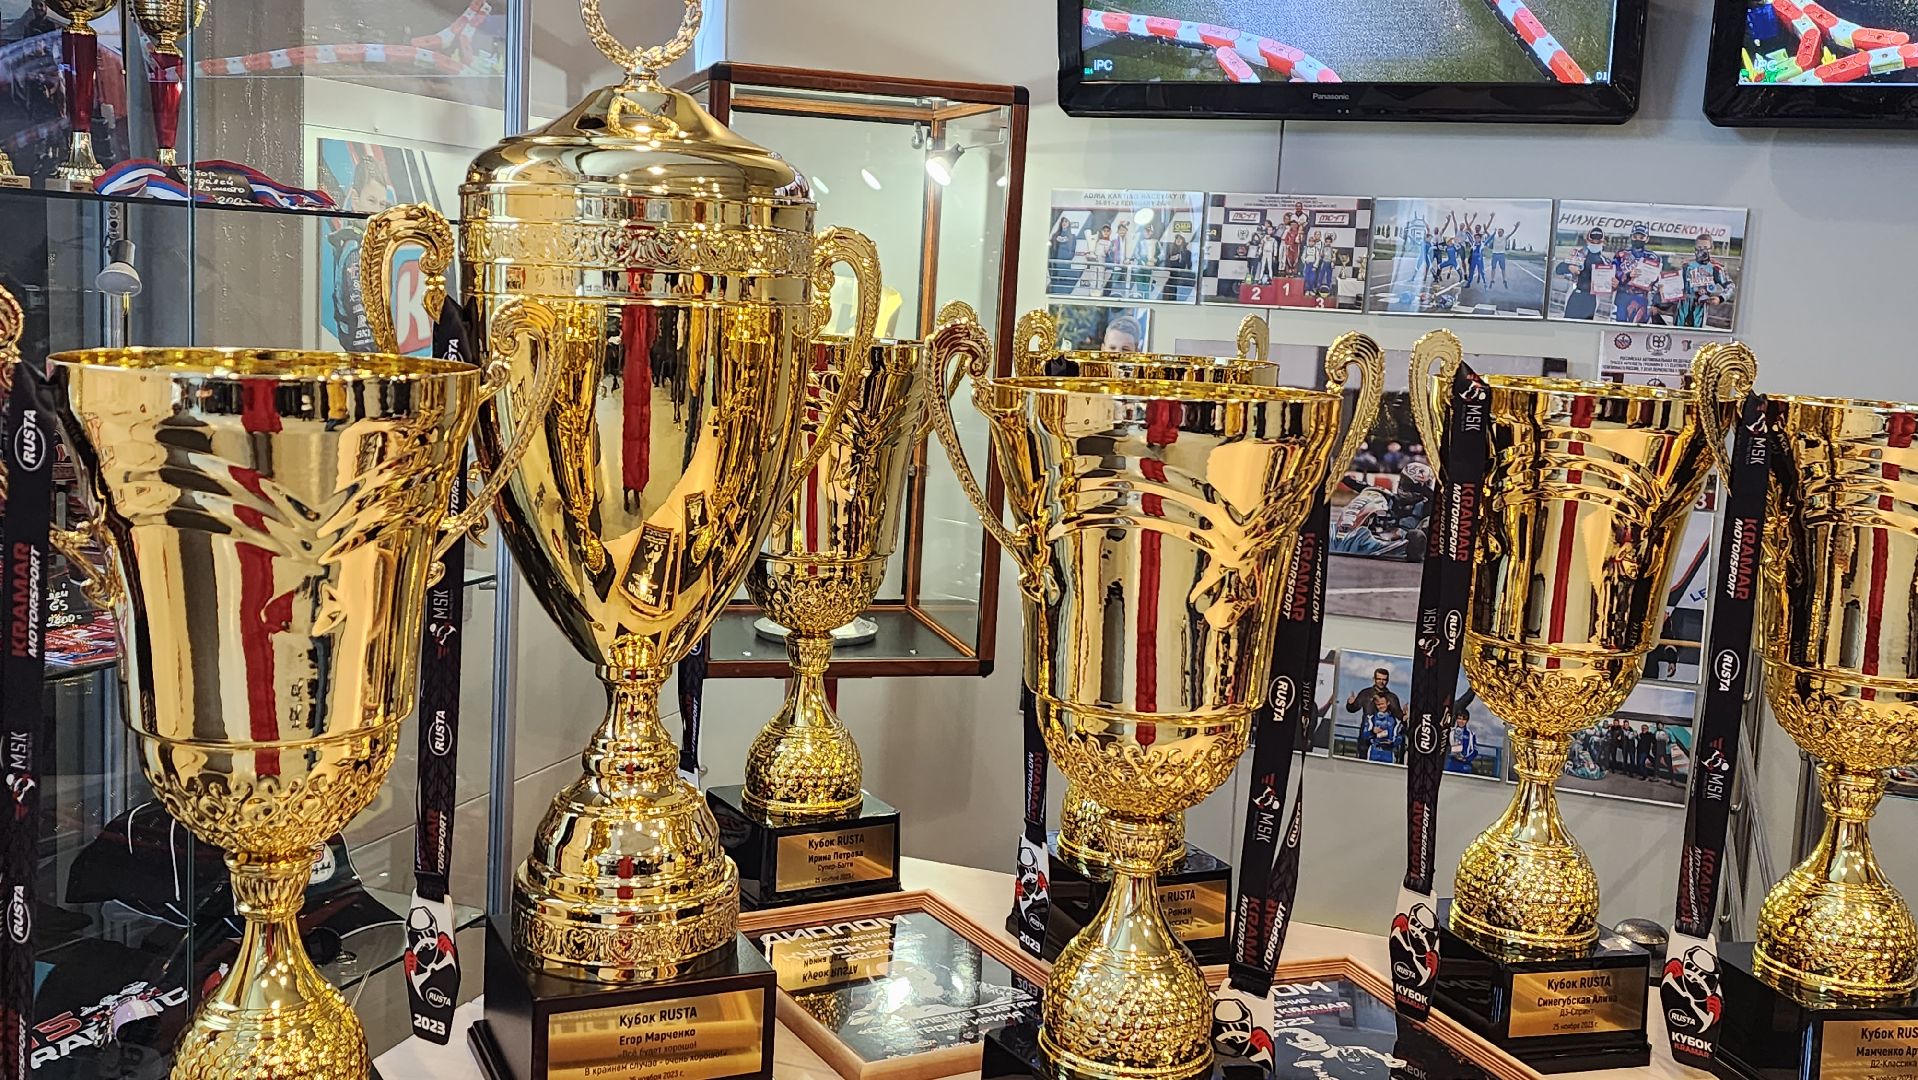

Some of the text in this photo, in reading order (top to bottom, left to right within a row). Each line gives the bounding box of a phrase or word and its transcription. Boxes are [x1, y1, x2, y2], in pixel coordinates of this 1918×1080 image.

[1093, 59, 1113, 71] IPC
[1312, 92, 1350, 100] Panasonic
[1251, 286, 1261, 300] 2
[1282, 283, 1290, 296] 1
[1315, 297, 1325, 309] 3
[1464, 403, 1482, 432] MSK
[23, 409, 37, 464] RUSTA
[1750, 437, 1767, 465] MSK
[1448, 482, 1462, 561] MOTORSPORT
[1457, 482, 1476, 562] KRAMAR
[1726, 517, 1744, 600] MOTORSPORT
[1734, 518, 1758, 601] KRAMAR
[1291, 531, 1317, 623] KRAMAR
[11, 542, 31, 657] KRAMAR
[27, 544, 42, 659] MOTORSPORT
[432, 588, 449, 620] MSK
[1422, 607, 1437, 634] MSK
[1448, 614, 1458, 651] RUSTA
[1718, 653, 1734, 693] RUSTA
[1272, 679, 1289, 722] RUSTA
[434, 709, 446, 752] RUSTA
[1421, 713, 1432, 751] RUSTA
[10, 730, 29, 771] MSK
[1707, 773, 1725, 801] MSK
[1255, 811, 1275, 844] MSK
[437, 811, 448, 876] TORSPORT
[808, 833, 865, 851] Кубок RUSTA
[1418, 804, 1432, 881] MOTORSPORT
[808, 854, 831, 865] Ирина
[1167, 889, 1196, 902] RUSTA
[13, 885, 25, 938] RUSTA
[760, 914, 912, 946] ДИПЛОМ
[1235, 893, 1249, 964] MOTORSPO
[1263, 901, 1287, 972] TORSPORT
[1019, 930, 1042, 954] 2023
[1395, 965, 1416, 980] RUSTA
[1547, 975, 1611, 992] Кубок RUSTA
[428, 990, 451, 1006] RUSTA
[1395, 983, 1429, 1006] КУБОК
[1537, 995, 1591, 1008] Синегубская
[619, 1006, 698, 1029] Кубок RUSTA
[1280, 1000, 1352, 1015] KRAMAR
[1670, 1010, 1697, 1027] RUSTA
[413, 1013, 446, 1037] 2023
[1273, 1016, 1316, 1028] 023
[1861, 1026, 1895, 1042] Кубок
[619, 1027, 696, 1047] Егор Марченко
[1671, 1030, 1713, 1053] КУБОК
[1673, 1042, 1711, 1059] KRAMAR
[1856, 1046, 1904, 1057] Мамченко
[584, 1067, 590, 1077] В
[592, 1063, 627, 1076] крайнем
[629, 1059, 657, 1071] случае
[665, 1056, 689, 1066] очень
[663, 1069, 679, 1079] 2023
